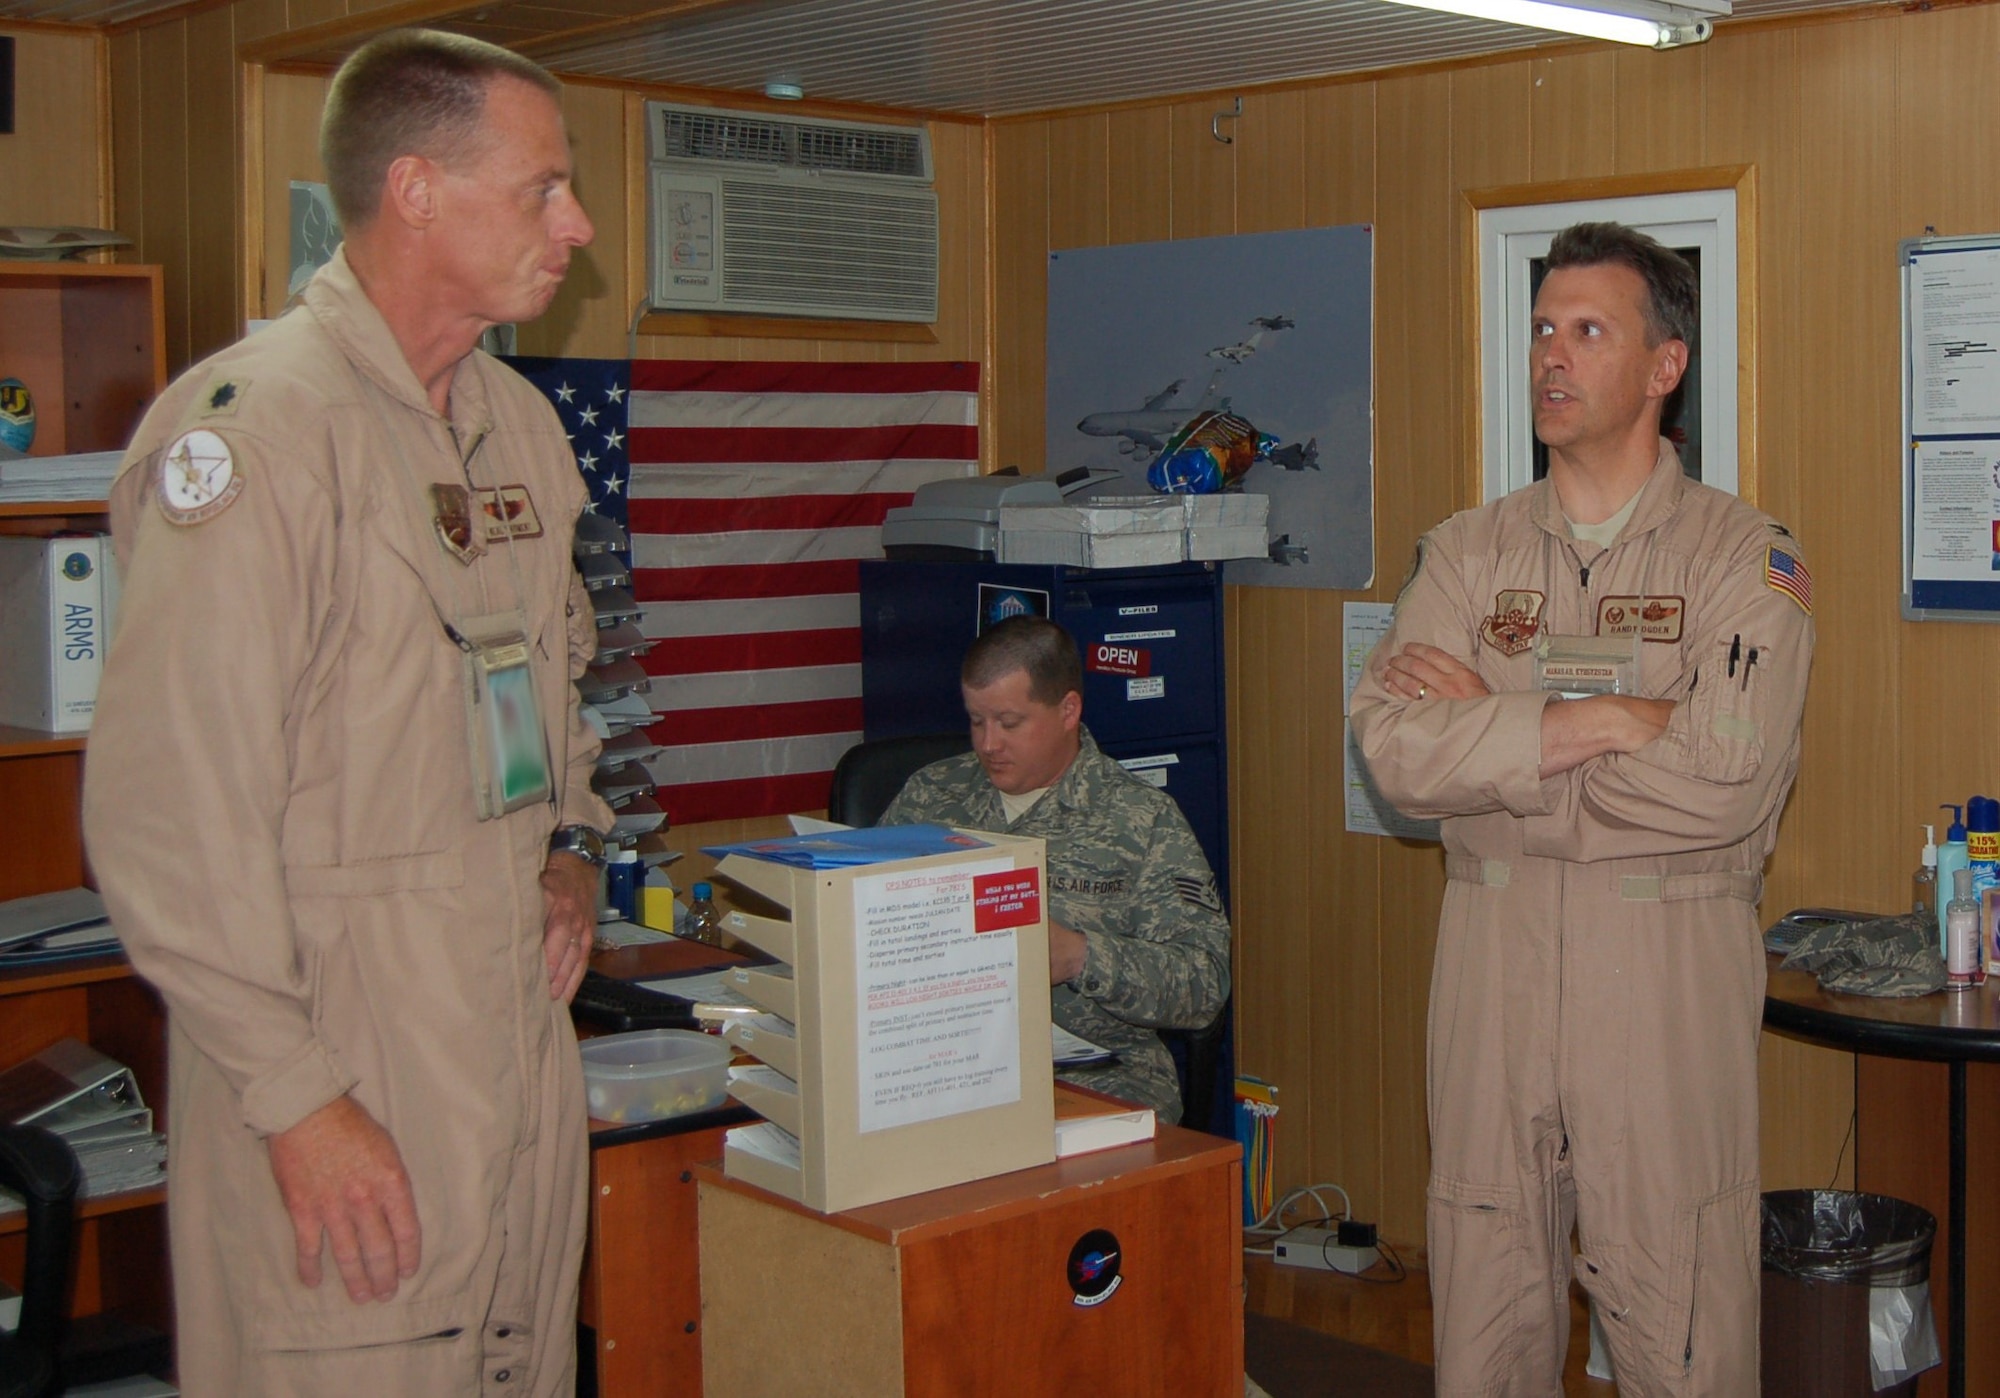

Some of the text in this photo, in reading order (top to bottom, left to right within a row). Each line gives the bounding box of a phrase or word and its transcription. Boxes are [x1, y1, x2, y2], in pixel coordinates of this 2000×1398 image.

[65, 603, 95, 661] ARMS
[1610, 625, 1670, 635] RANDY OGDEN
[1097, 646, 1139, 666] OPEN
[1976, 836, 1997, 846] 15%
[885, 880, 900, 890] OPS
[901, 876, 927, 888] NOTES
[1003, 883, 1014, 892] YOU
[1070, 878, 1090, 893] AIR
[1093, 879, 1125, 894] FORCE
[902, 899, 920, 910] model
[924, 908, 945, 917] JULIAN
[946, 905, 960, 914] DATE
[870, 920, 929, 937] CHECK DURATION
[887, 935, 902, 944] total
[903, 931, 928, 943] landings
[928, 929, 939, 938] and
[940, 926, 961, 936] sorties
[896, 944, 919, 954] primary
[920, 939, 948, 951] secondary
[979, 932, 992, 940] time
[993, 929, 1012, 939] equally
[881, 958, 895, 967] total
[897, 956, 910, 965] time
[911, 954, 922, 962] and
[924, 950, 945, 960] sorties
[885, 1038, 913, 1050] COMBAT
[915, 1035, 931, 1045] TIME
[933, 1032, 947, 1042] AND
[874, 1087, 892, 1097] EVEN
